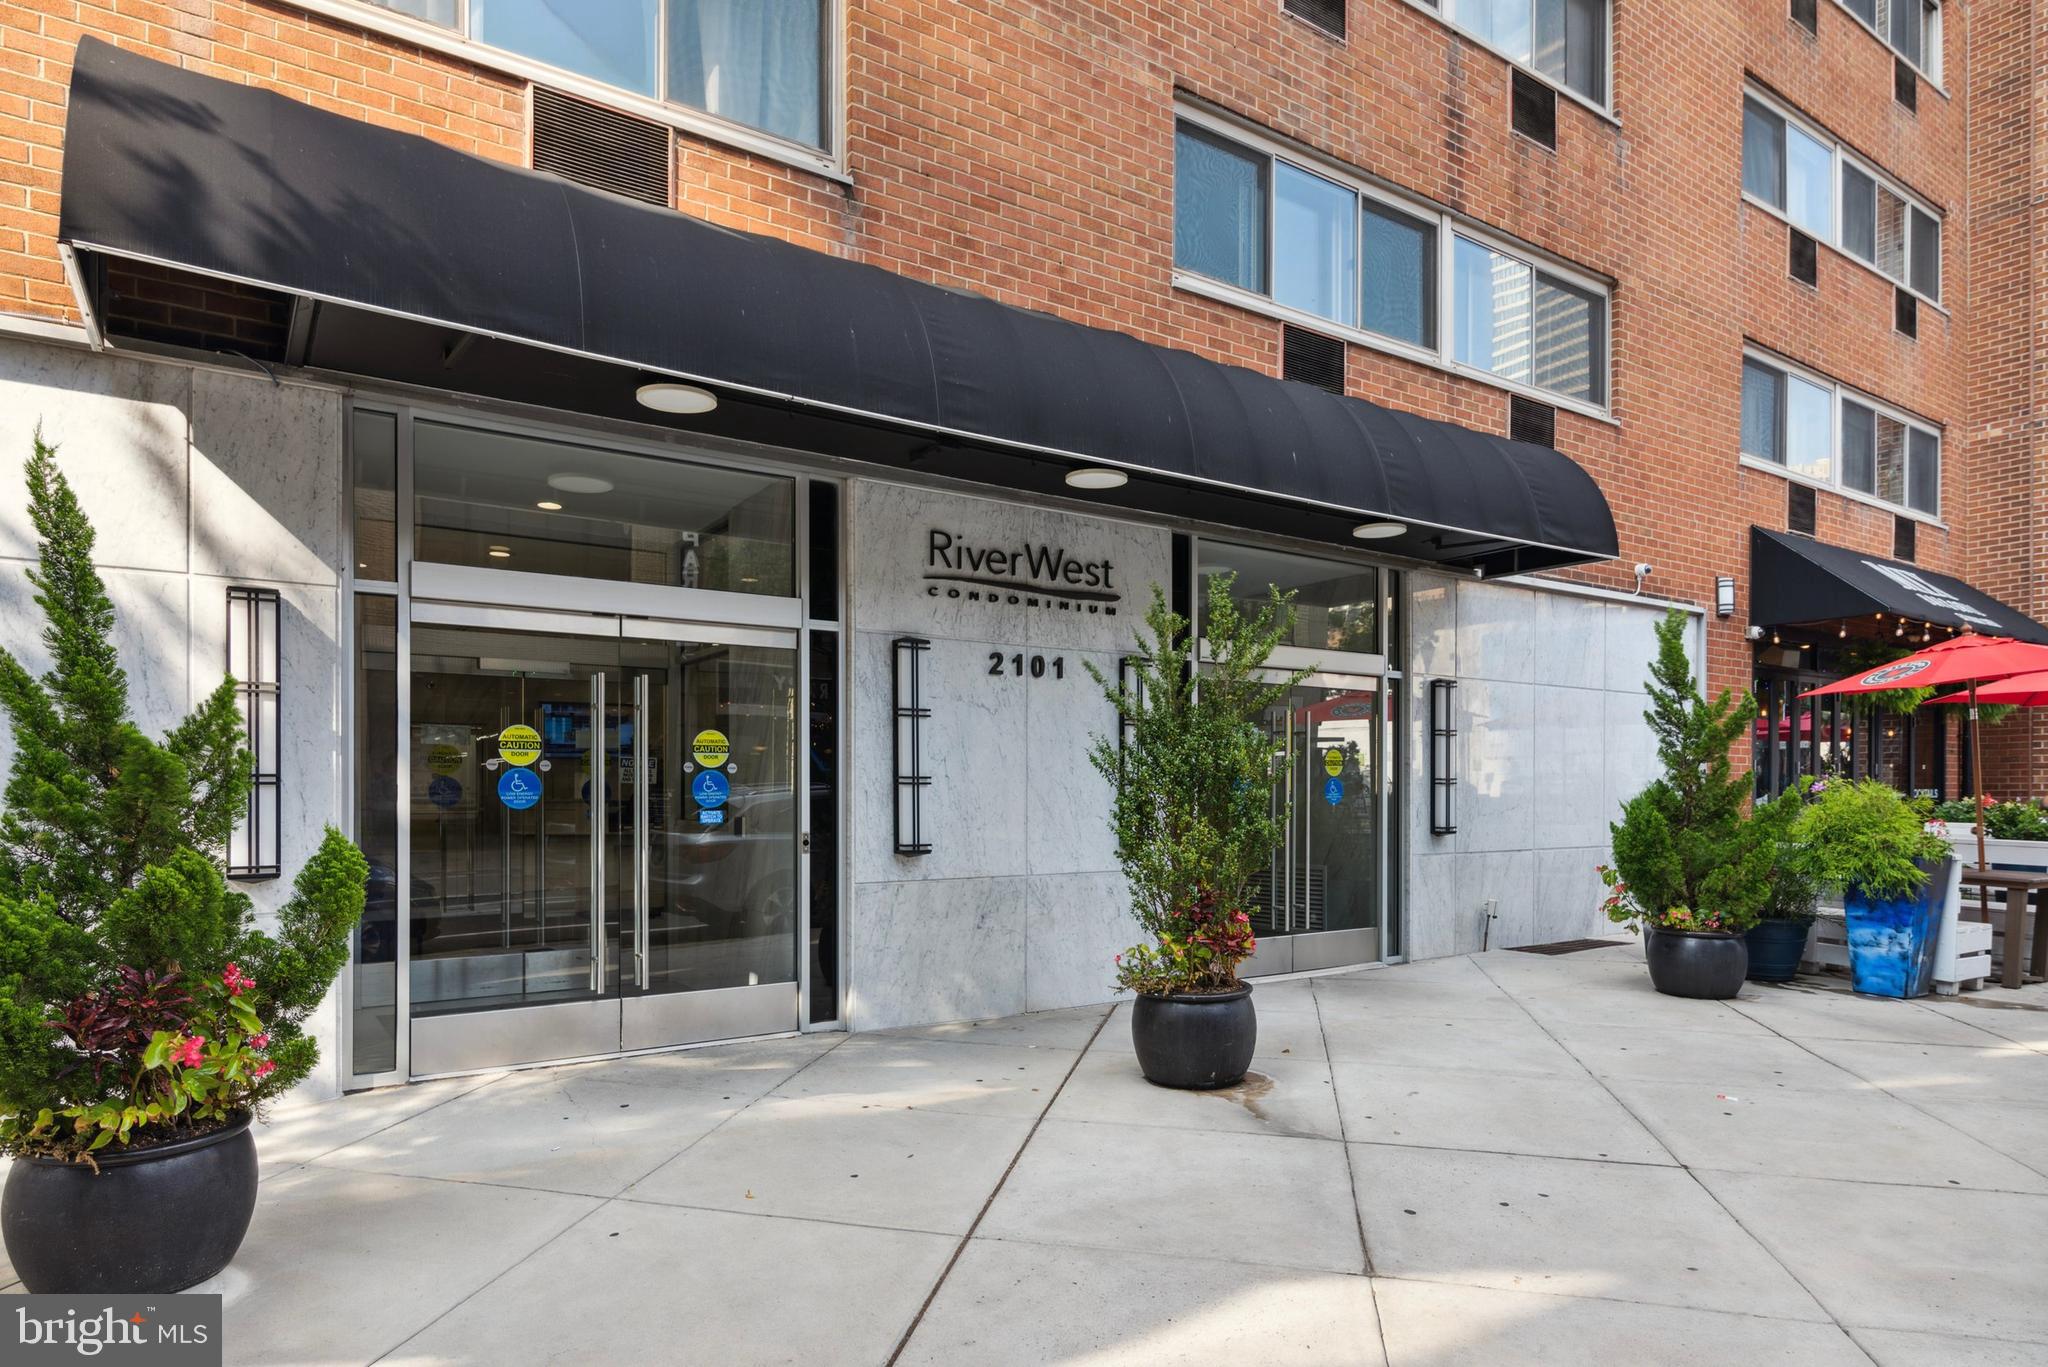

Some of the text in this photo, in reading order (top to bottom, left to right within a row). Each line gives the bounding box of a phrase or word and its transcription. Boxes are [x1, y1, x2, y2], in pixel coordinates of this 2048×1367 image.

[928, 529, 1115, 589] RiverWest
[927, 586, 1117, 616] CONDOMINIUM
[988, 652, 1065, 680] 2101
[500, 741, 540, 749] CAUTION
[694, 745, 728, 753] CAUTION
